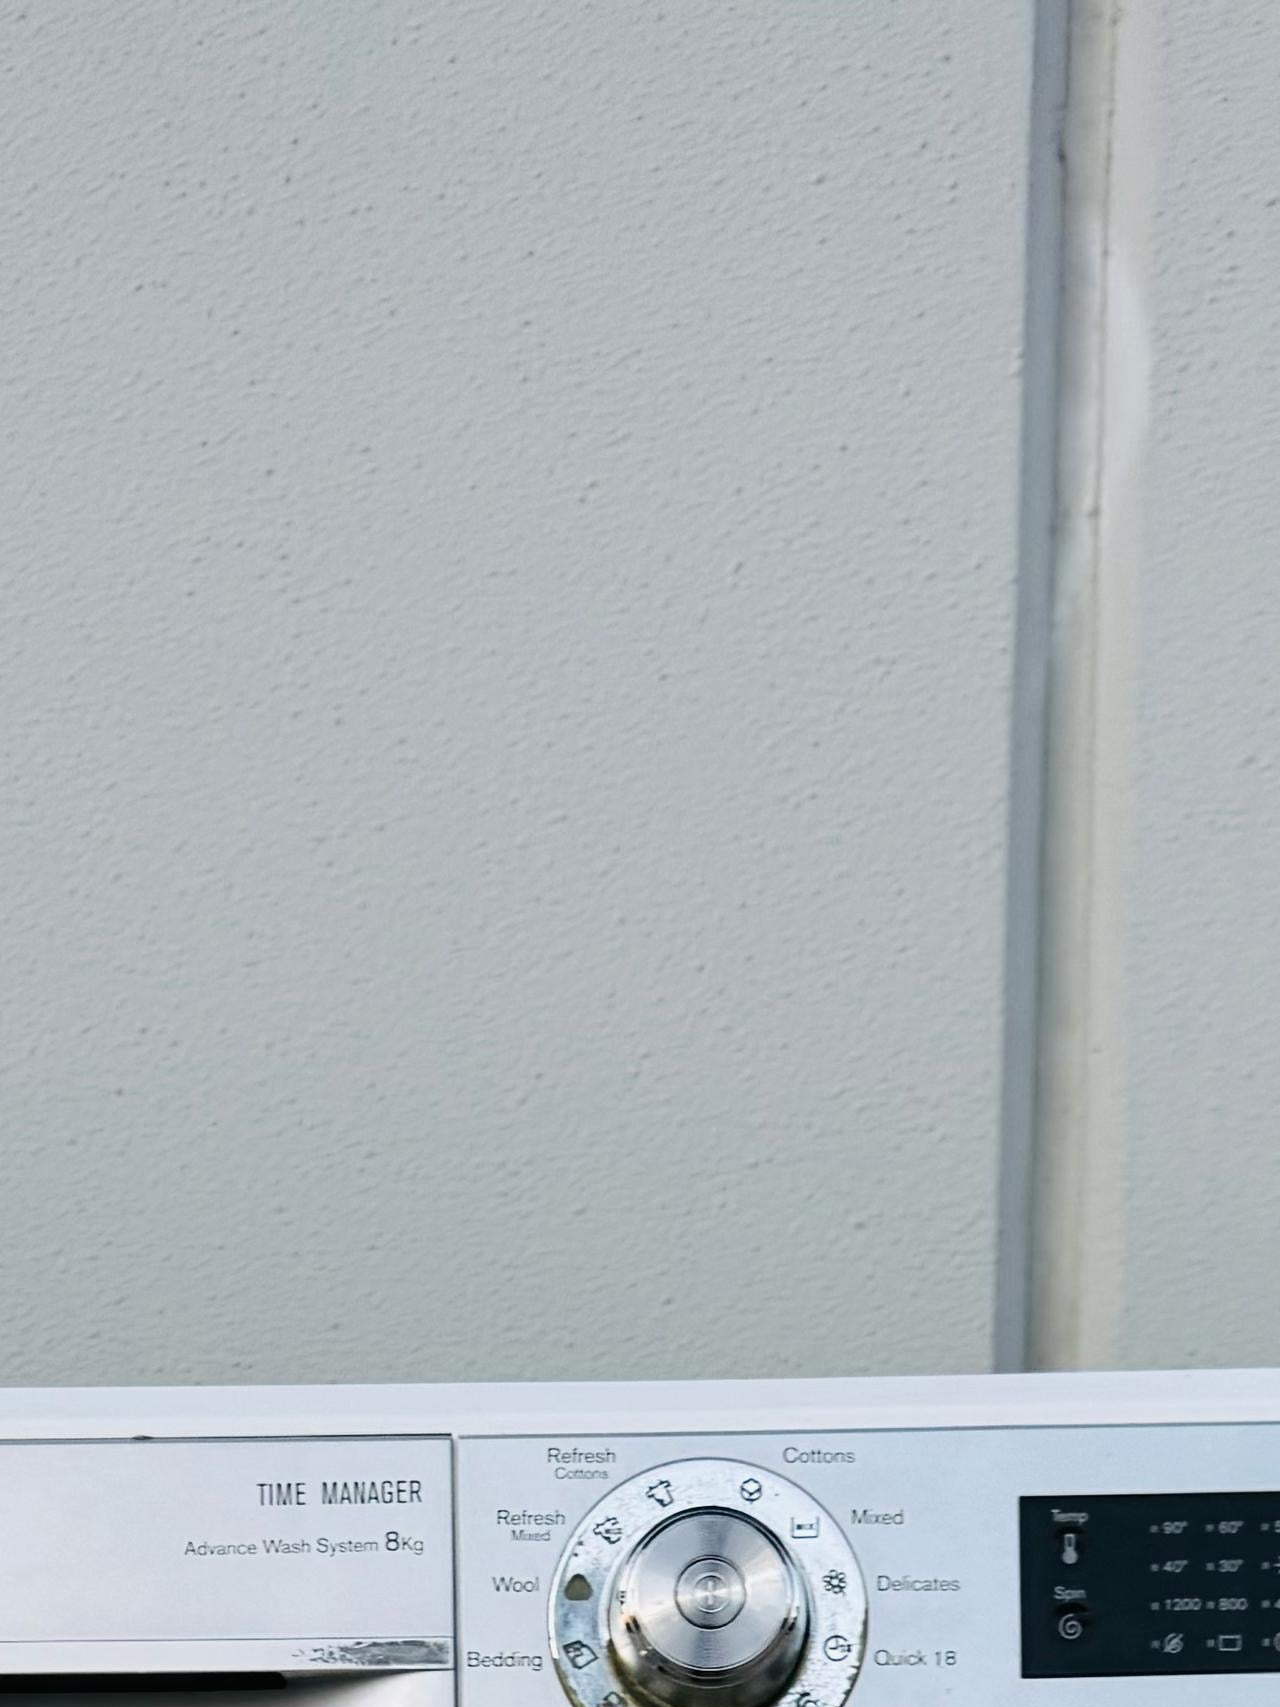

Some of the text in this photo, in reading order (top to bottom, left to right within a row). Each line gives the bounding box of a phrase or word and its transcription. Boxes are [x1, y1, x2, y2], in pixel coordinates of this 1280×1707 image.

[547, 1447, 616, 1464] Refresh
[782, 1447, 856, 1464] Cottons
[256, 1480, 422, 1506] TIME MANAGER
[496, 1509, 565, 1526] Refresh
[851, 1509, 904, 1525] Mixed
[183, 1541, 257, 1556] Advance
[262, 1539, 310, 1554] Wash
[316, 1537, 378, 1557] System
[492, 1576, 540, 1592] Wool
[877, 1575, 961, 1592] Delicates
[467, 1651, 543, 1671] Bedding
[874, 1649, 957, 1666] Quick 18
